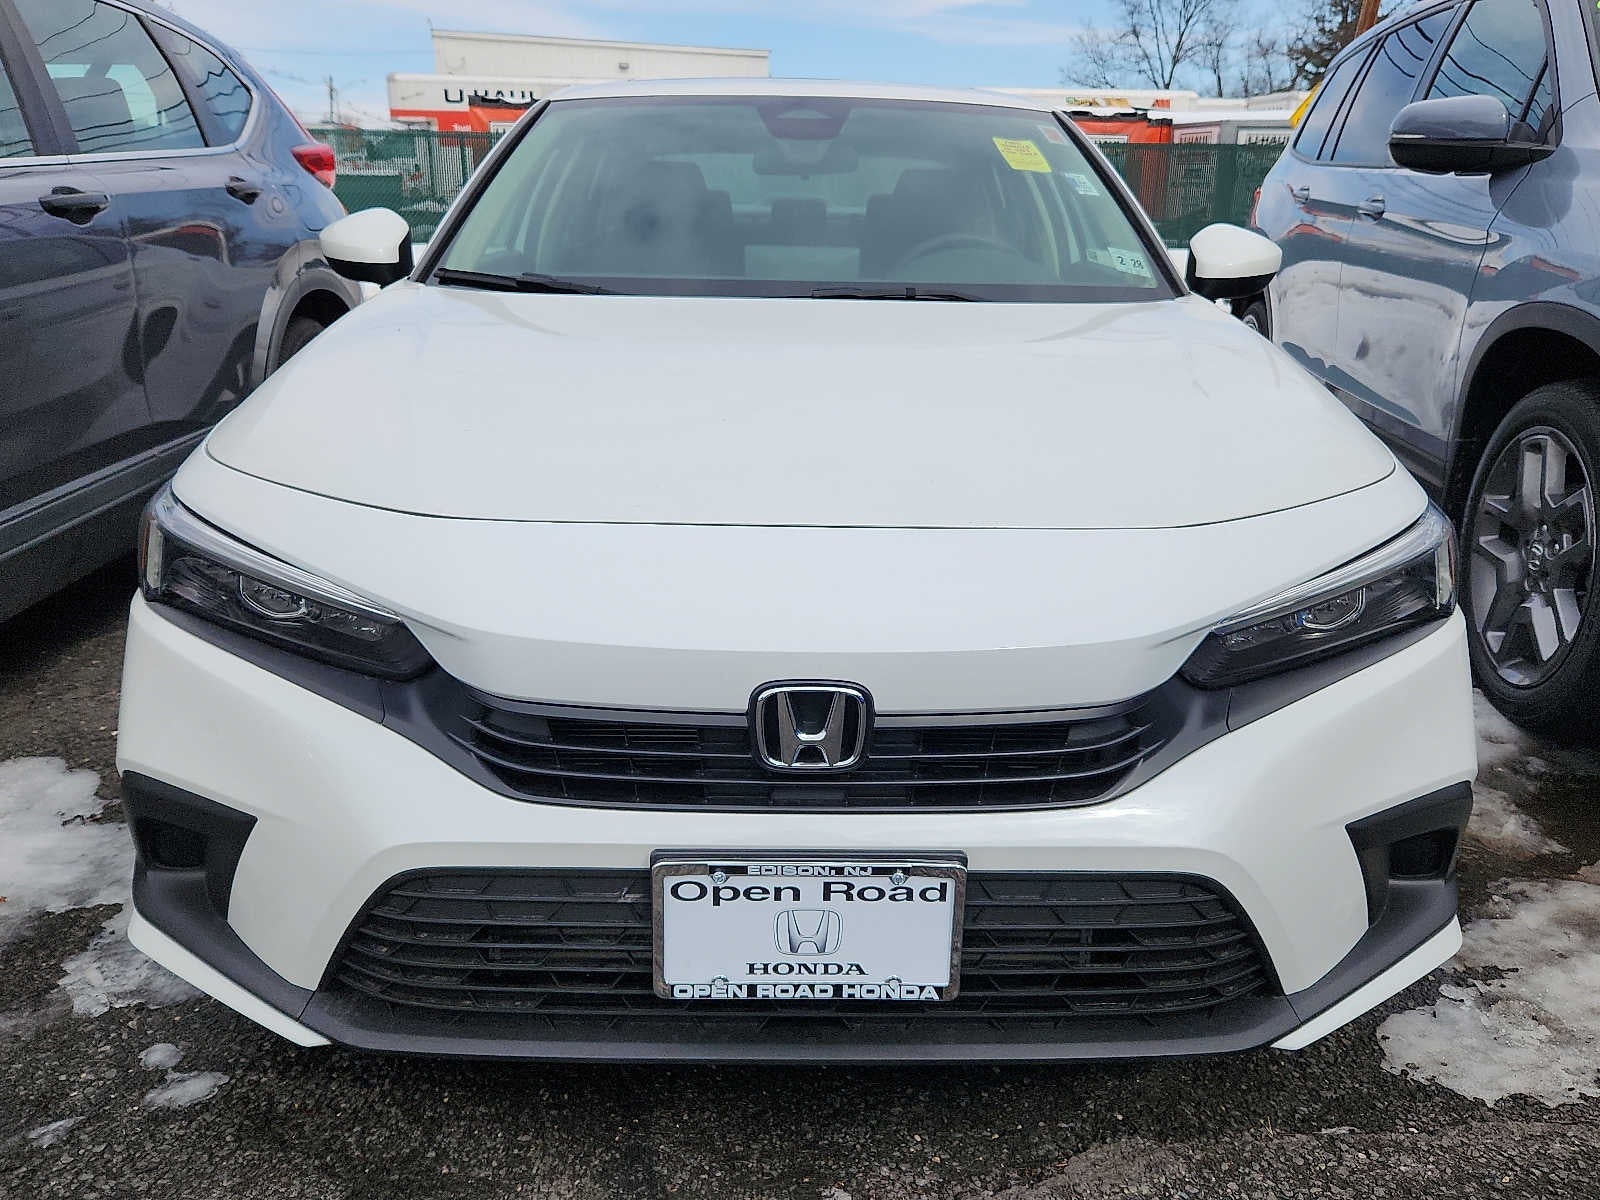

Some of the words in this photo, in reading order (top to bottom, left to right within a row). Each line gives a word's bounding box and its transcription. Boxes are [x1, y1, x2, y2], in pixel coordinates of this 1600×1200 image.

[844, 865, 873, 876] NJ
[670, 880, 801, 907] Open
[822, 881, 948, 903] Road
[745, 962, 869, 976] HONDA
[673, 984, 748, 998] OPEN
[756, 984, 834, 998] ROAD
[842, 984, 940, 1000] HONDA
